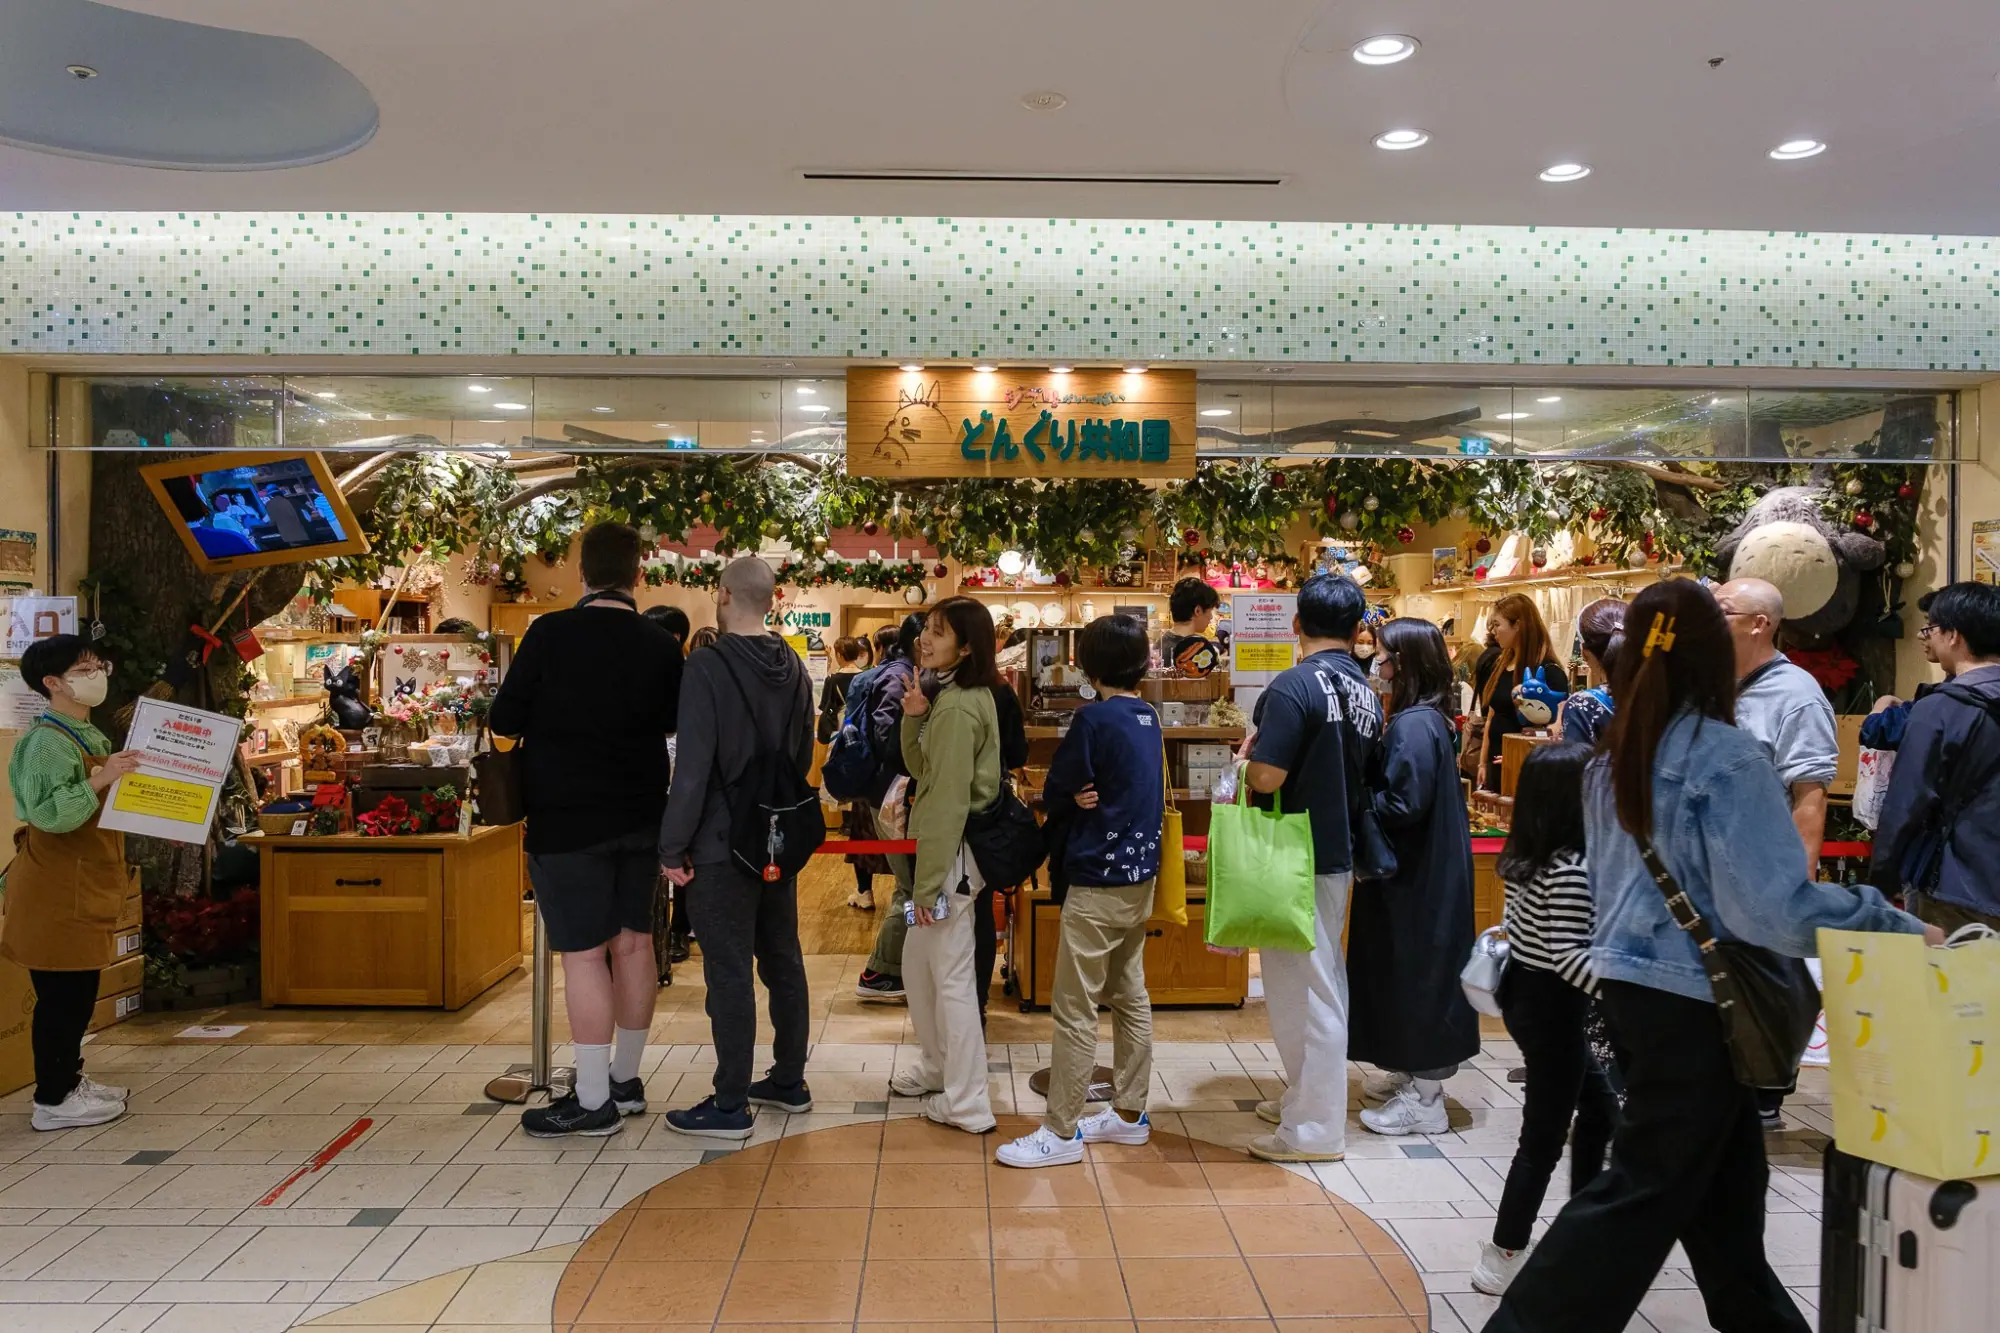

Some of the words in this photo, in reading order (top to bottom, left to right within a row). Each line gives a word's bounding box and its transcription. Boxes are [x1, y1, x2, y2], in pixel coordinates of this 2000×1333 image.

[960, 409, 1171, 463] どんぐり共和国
